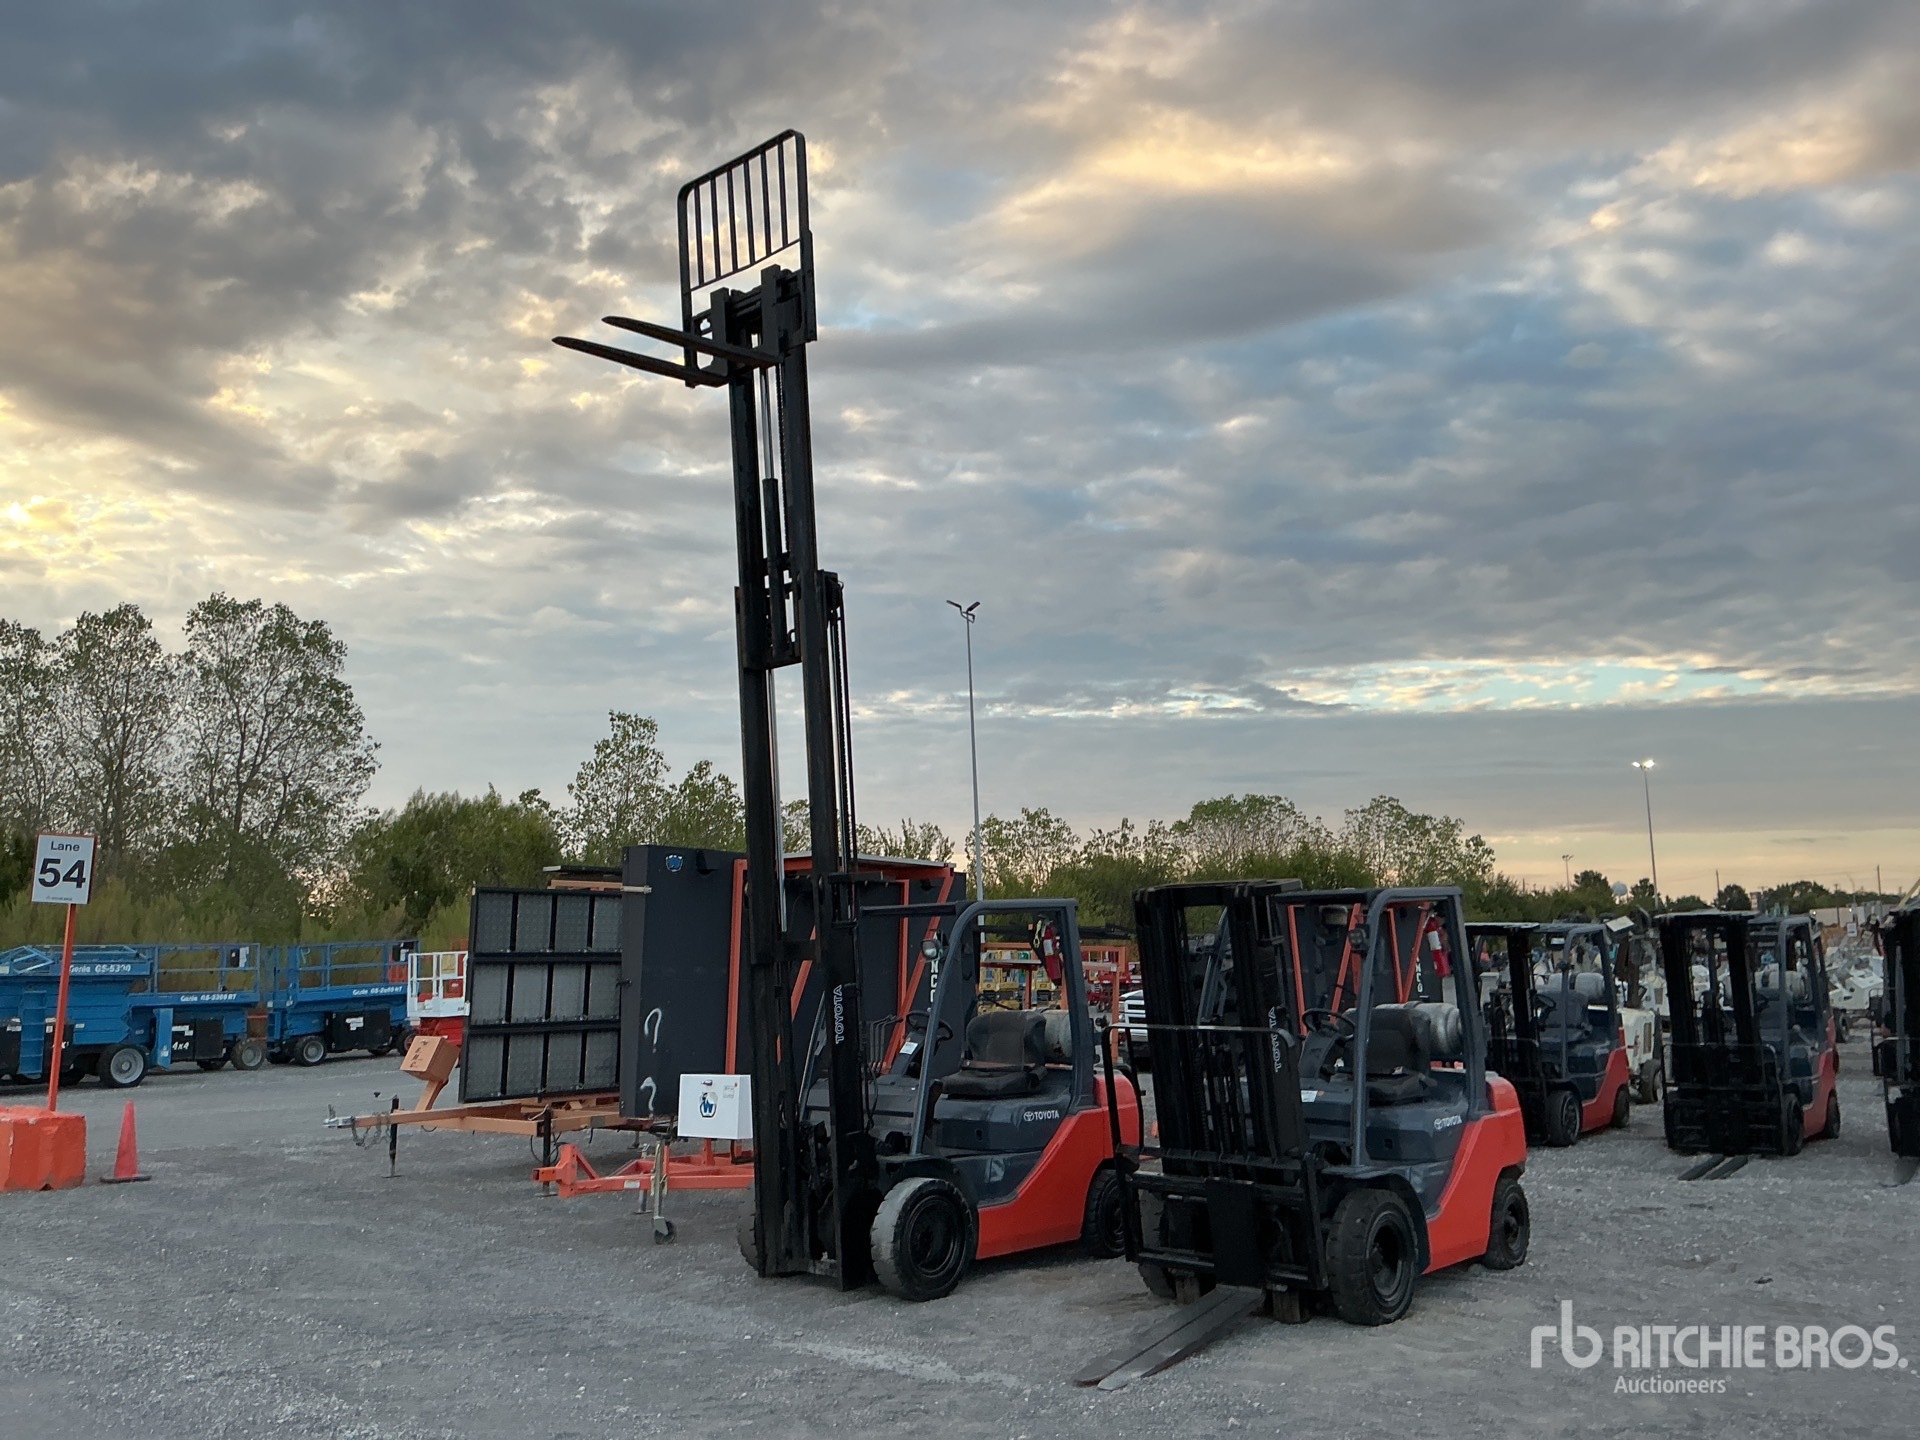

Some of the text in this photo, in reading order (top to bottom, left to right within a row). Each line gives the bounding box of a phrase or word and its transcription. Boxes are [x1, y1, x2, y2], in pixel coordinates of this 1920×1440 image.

[51, 841, 80, 851] Lane
[38, 858, 86, 888] 54
[832, 984, 845, 1045] TOYOTA
[172, 1041, 190, 1051] 4x4
[1034, 1110, 1060, 1121] TOYOTA
[1441, 1115, 1463, 1128] TOYOTA
